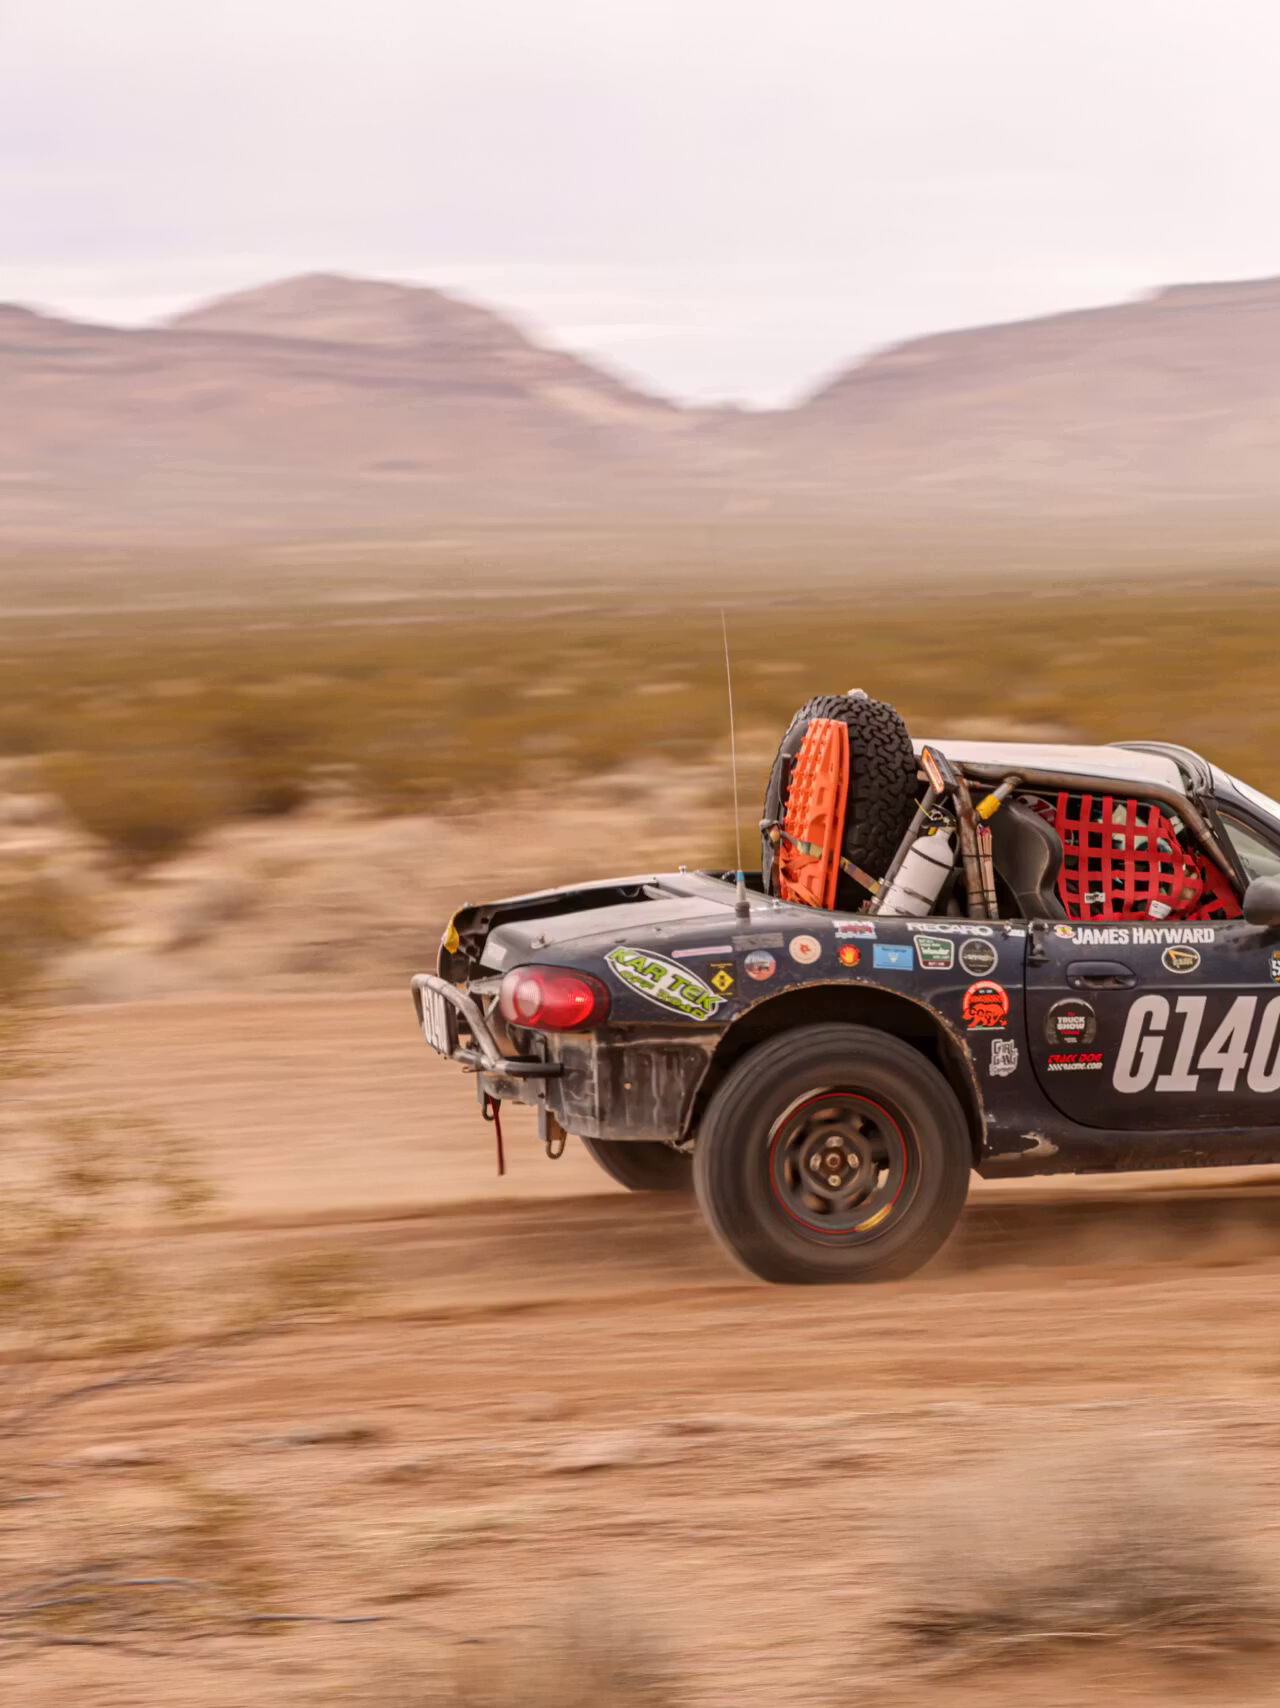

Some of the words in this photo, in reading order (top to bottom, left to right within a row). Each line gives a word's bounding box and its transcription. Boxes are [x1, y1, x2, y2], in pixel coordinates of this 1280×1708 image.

[905, 922, 994, 937] RECARO
[1072, 927, 1129, 945] JAMES
[1132, 927, 1215, 945] HAYWARD
[608, 948, 667, 984] KAR
[667, 973, 722, 1013] TEK
[1057, 1016, 1085, 1024] TRUCK
